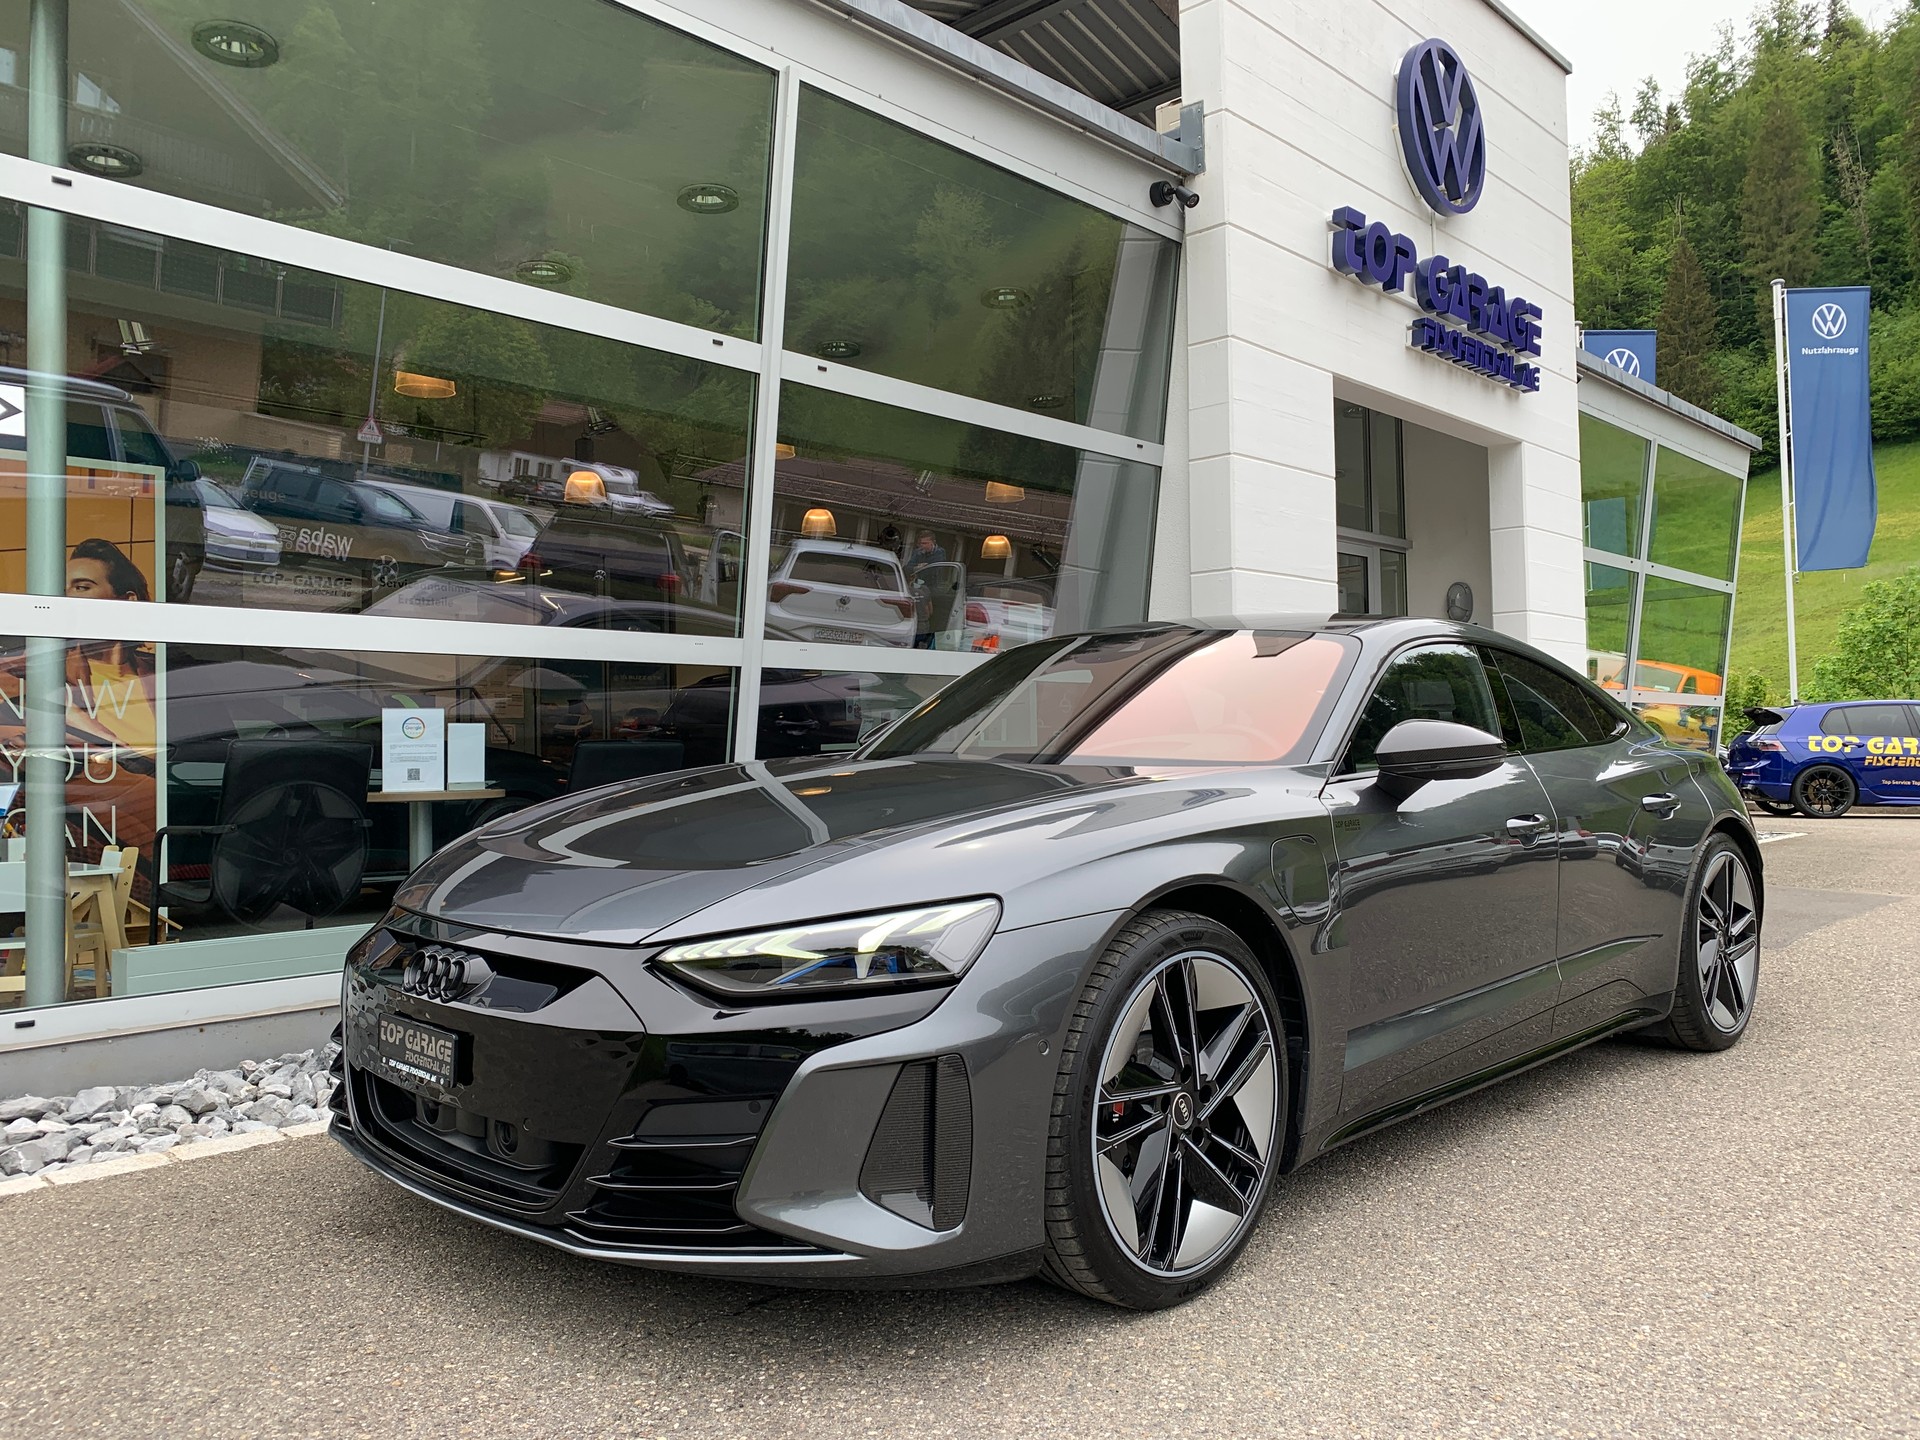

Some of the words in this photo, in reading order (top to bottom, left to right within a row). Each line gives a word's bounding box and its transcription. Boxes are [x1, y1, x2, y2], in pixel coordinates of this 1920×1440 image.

[1332, 206, 1417, 295] TOP
[1415, 254, 1543, 359] GARAGE
[1411, 317, 1517, 385] FISCHENTHAL
[1510, 362, 1541, 393] AG
[1801, 346, 1859, 355] Nutzfahrzeuge
[1867, 737, 1920, 755] GAR
[380, 1020, 404, 1045] TOP
[405, 1029, 453, 1063] GARAGE
[441, 1064, 451, 1076] AG
